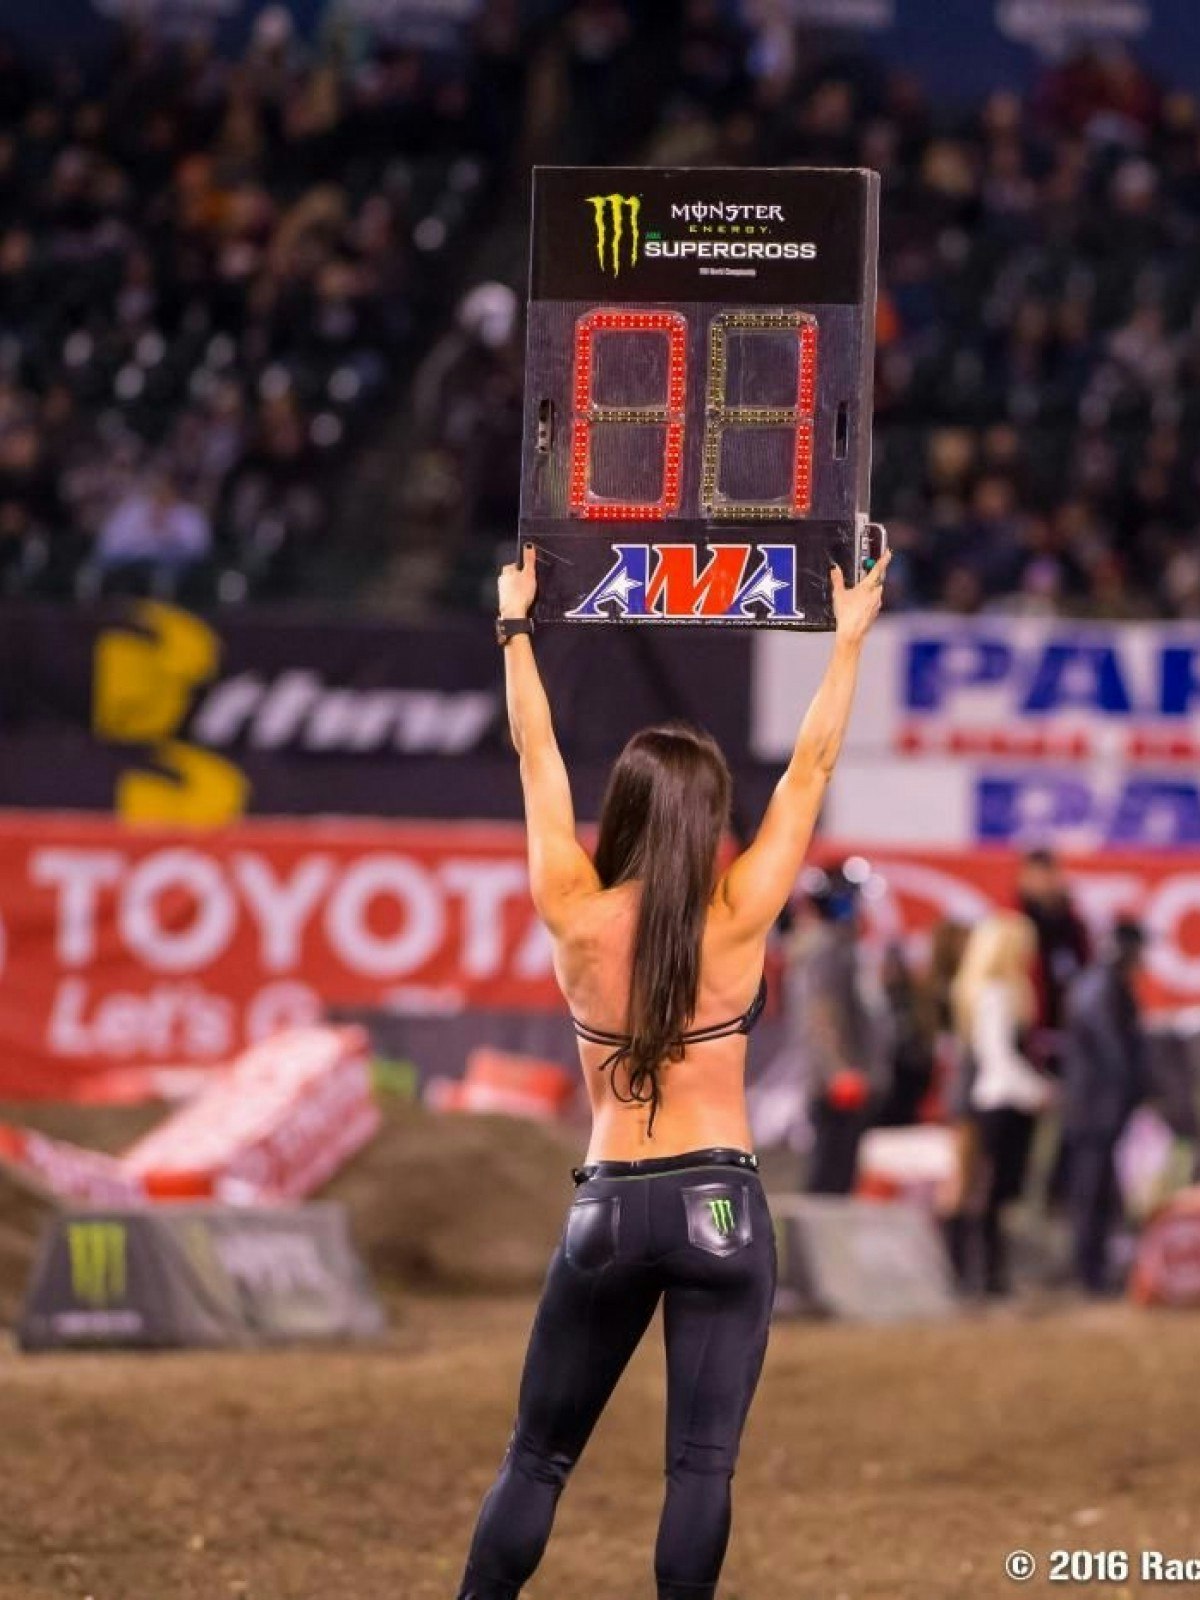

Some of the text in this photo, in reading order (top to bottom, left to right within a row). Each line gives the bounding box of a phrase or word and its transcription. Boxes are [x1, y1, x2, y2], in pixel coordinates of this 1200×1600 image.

[671, 201, 785, 222] MONSTER
[644, 241, 817, 259] SUPERCROSS
[564, 543, 806, 619] AMA
